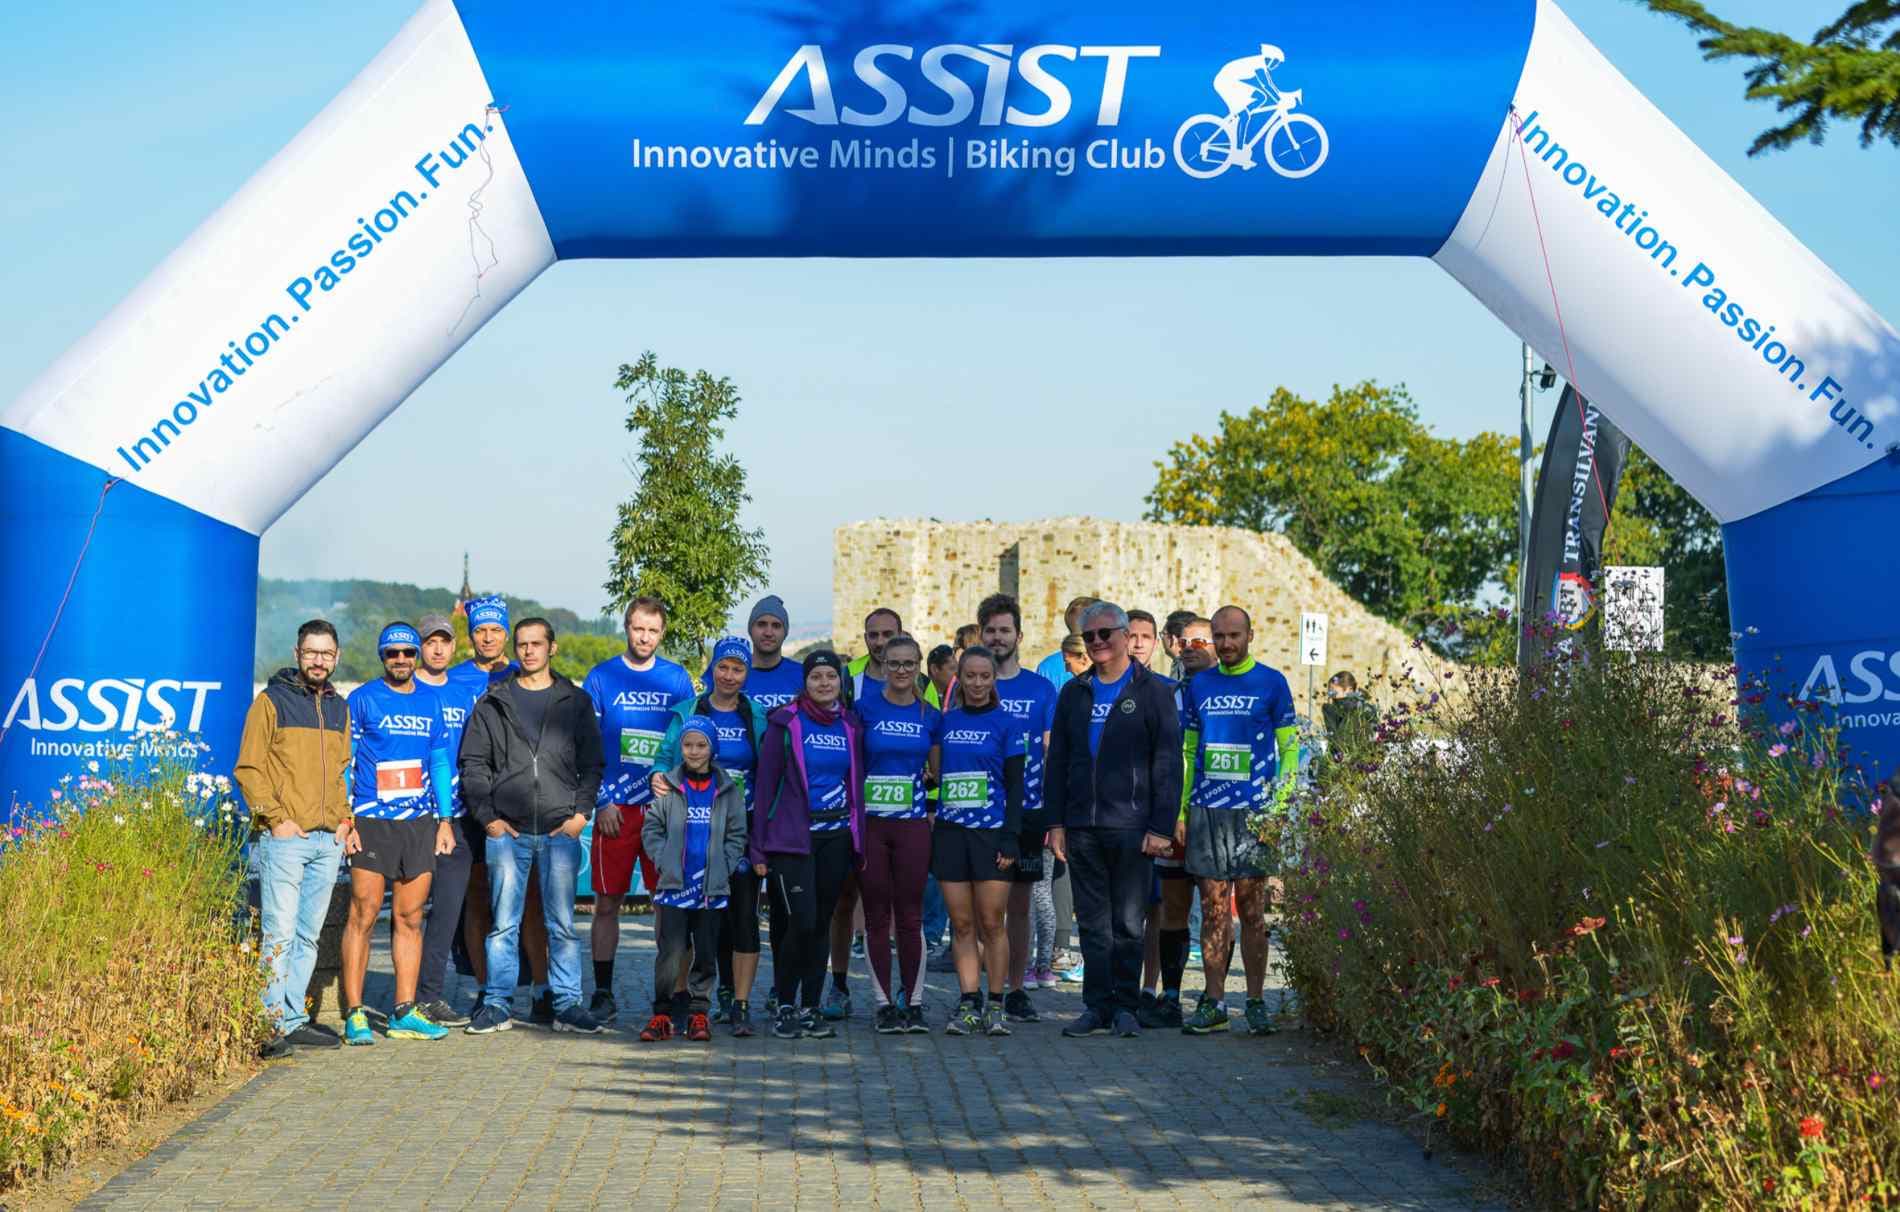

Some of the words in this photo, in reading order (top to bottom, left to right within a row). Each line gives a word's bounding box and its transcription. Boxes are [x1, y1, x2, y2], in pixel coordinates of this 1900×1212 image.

[743, 44, 1162, 126] ASSIST
[633, 139, 819, 170] Innovative
[829, 138, 937, 170] Minds
[966, 138, 1076, 177] Biking
[1086, 138, 1166, 170] Club
[1518, 110, 1678, 277] Innovation.
[1682, 262, 1806, 391] Passion.
[1808, 376, 1876, 450] Fun.
[116, 313, 300, 472] Innovation.
[286, 191, 428, 312] Passion.
[414, 122, 494, 189] Fun.
[2, 678, 222, 732] ASSIST
[612, 691, 672, 706] ASSIST
[1199, 695, 1260, 710] ASSIST
[378, 714, 433, 731] ASSIST
[873, 720, 924, 734] ASSIST
[804, 733, 848, 747] ASSIST
[943, 730, 991, 741] ASSIST
[32, 737, 135, 758] Innovative
[628, 738, 660, 757] 267
[1210, 752, 1240, 770] 261
[397, 770, 406, 788] 1
[872, 784, 905, 802] 278
[947, 781, 979, 799] 262
